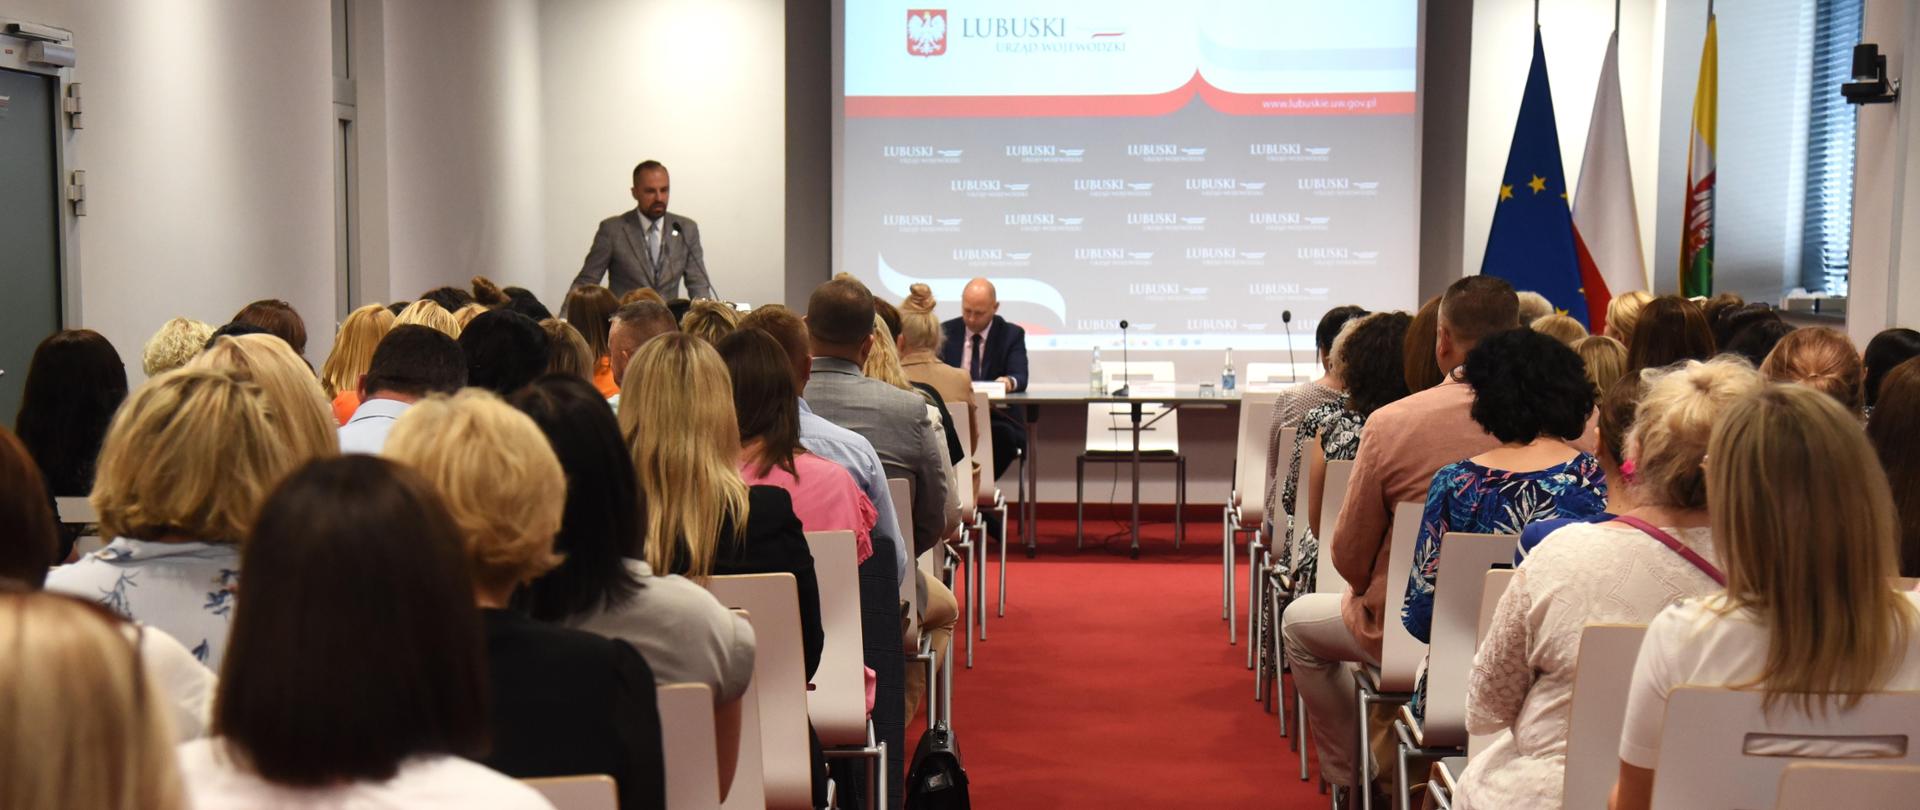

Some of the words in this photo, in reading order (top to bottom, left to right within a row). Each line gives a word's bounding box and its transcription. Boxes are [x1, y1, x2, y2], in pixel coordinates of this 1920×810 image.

[962, 18, 1065, 38] LUBUSKI
[1263, 97, 1377, 110] www.lubuskie.uw.gov.pl
[884, 146, 933, 157] LUBUSKI
[1006, 145, 1055, 156] LUBUSKI
[1128, 144, 1177, 155] LUBUSKI
[1250, 144, 1300, 155] LUBUSKI
[951, 180, 1000, 191] LUBUSKI
[1074, 179, 1124, 190] LUBUSKI
[1186, 179, 1235, 189] LUBUSKI
[1298, 178, 1348, 189] LUBUSKI
[883, 215, 932, 225] LUBUSKI
[1005, 214, 1054, 225] LUBUSKI
[1128, 213, 1176, 224] LUBUSKI
[1250, 213, 1299, 224] LUBUSKI
[953, 249, 1002, 260] LUBUSKI
[1075, 248, 1124, 259] LUBUSKI
[1186, 248, 1235, 258] LUBUSKI
[1297, 248, 1348, 258] LUBUSKI
[1129, 283, 1179, 294] LUBUSKI
[1249, 283, 1299, 294] LUBUSKI
[1078, 320, 1122, 330] LUBUSK
[1187, 320, 1237, 330] LUBUSKI
